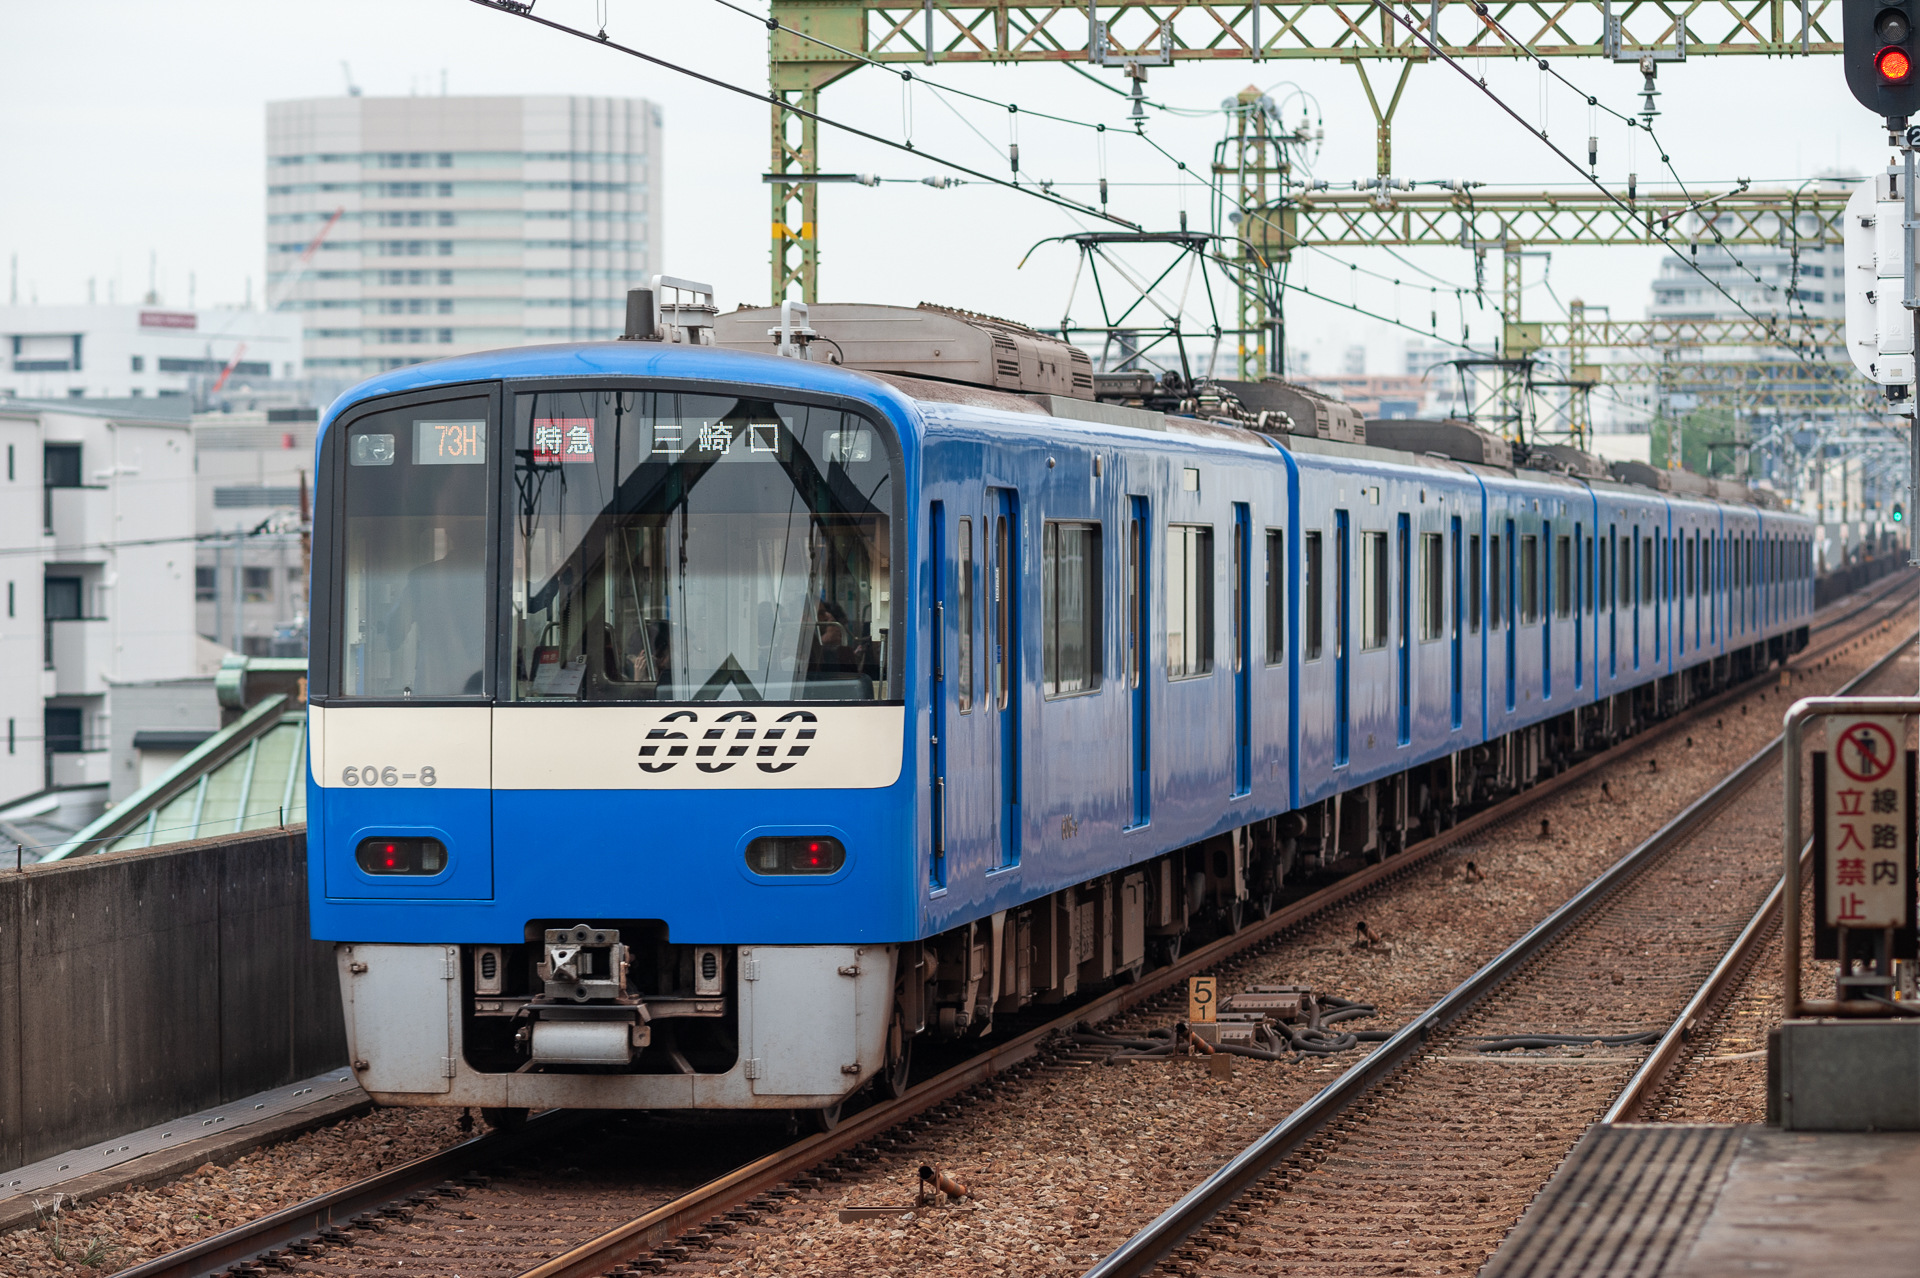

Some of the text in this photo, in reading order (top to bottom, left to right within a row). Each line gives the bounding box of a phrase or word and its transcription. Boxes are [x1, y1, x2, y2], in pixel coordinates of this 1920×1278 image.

[435, 425, 476, 456] 73H
[536, 426, 593, 454] 特急
[651, 421, 779, 455] 三崎口
[638, 710, 818, 774] 600
[342, 765, 437, 786] 606-8
[1872, 787, 1898, 886] 線路内
[1837, 788, 1866, 920] 立入禁止
[1194, 980, 1212, 1004] 5
[1198, 1004, 1206, 1020] 1
